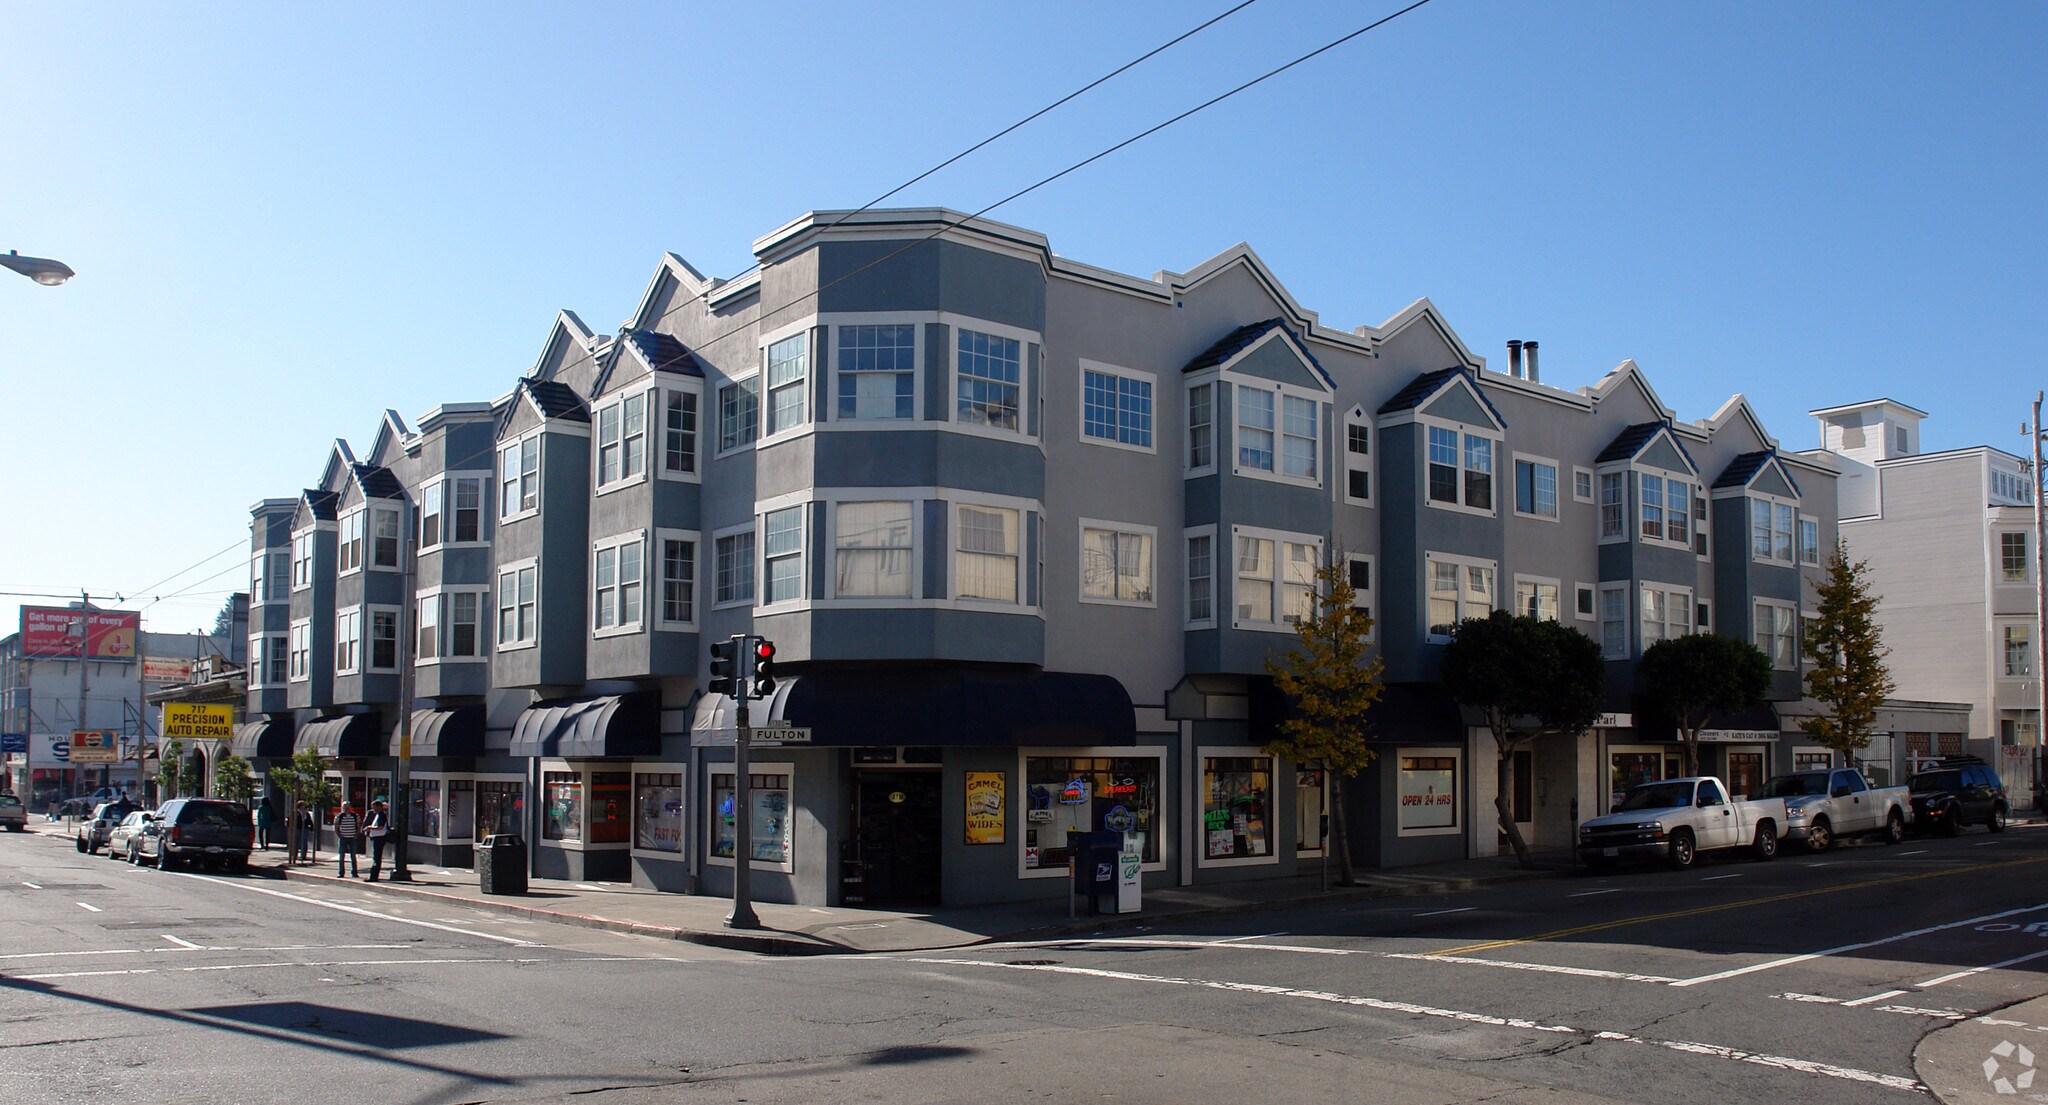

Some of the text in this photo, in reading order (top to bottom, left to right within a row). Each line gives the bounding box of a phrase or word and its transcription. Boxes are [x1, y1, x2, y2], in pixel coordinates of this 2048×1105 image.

[28, 611, 45, 621] Get
[46, 614, 70, 623] more
[88, 615, 97, 623] of
[99, 616, 124, 626] every
[28, 623, 56, 633] gallon
[57, 624, 67, 632] of
[191, 705, 207, 713] 717
[172, 713, 225, 725] PRECISION
[166, 725, 230, 736] AUTO REPAIR
[757, 730, 805, 739] FULTON
[968, 780, 1003, 791] CAMEL
[1402, 794, 1451, 806] OPEN 24 HRS
[1029, 811, 1053, 819] CAMEL
[967, 820, 1003, 829] WIDES
[654, 827, 669, 841] FAST
